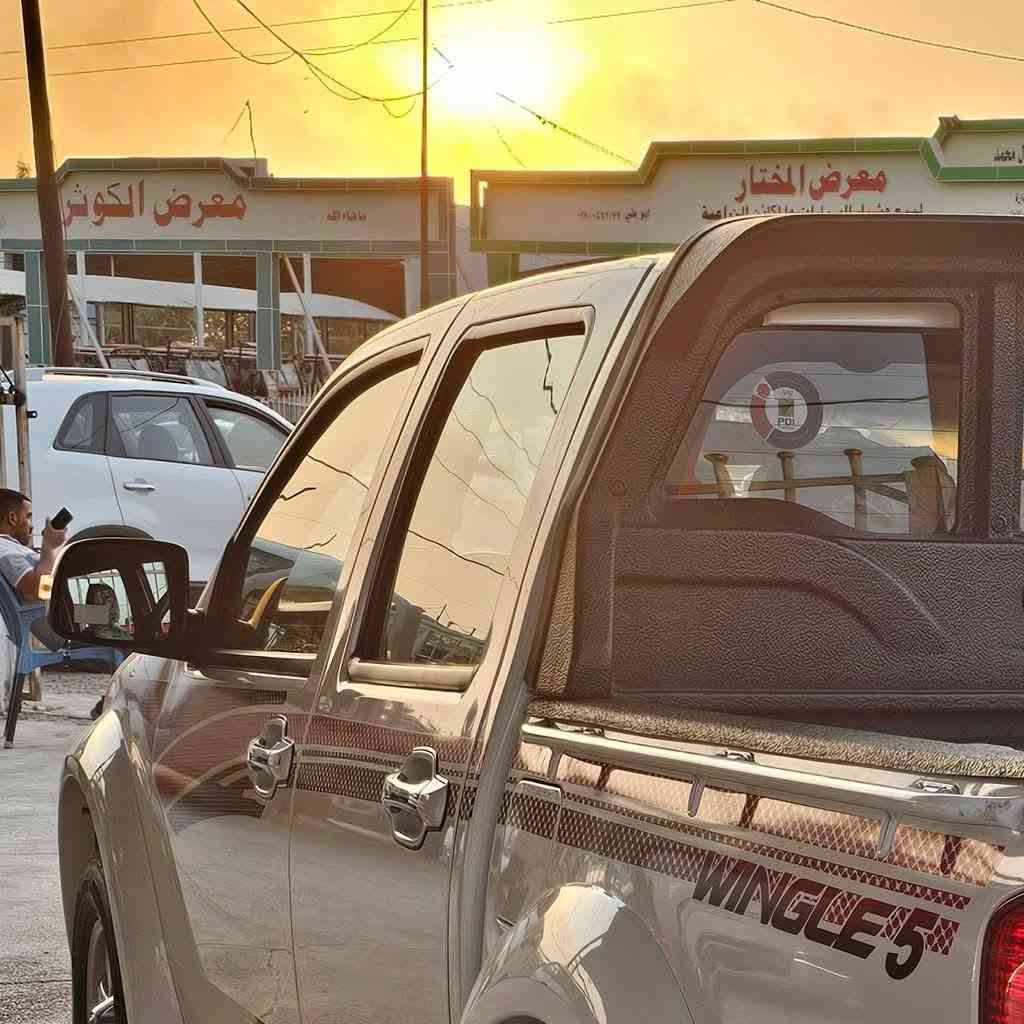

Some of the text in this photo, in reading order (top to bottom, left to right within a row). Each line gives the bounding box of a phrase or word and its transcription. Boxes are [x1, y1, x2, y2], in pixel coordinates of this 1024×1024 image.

[63, 178, 248, 228] معرض الكوثر
[734, 163, 888, 203] معرض المختار
[692, 850, 897, 960] WINGLE
